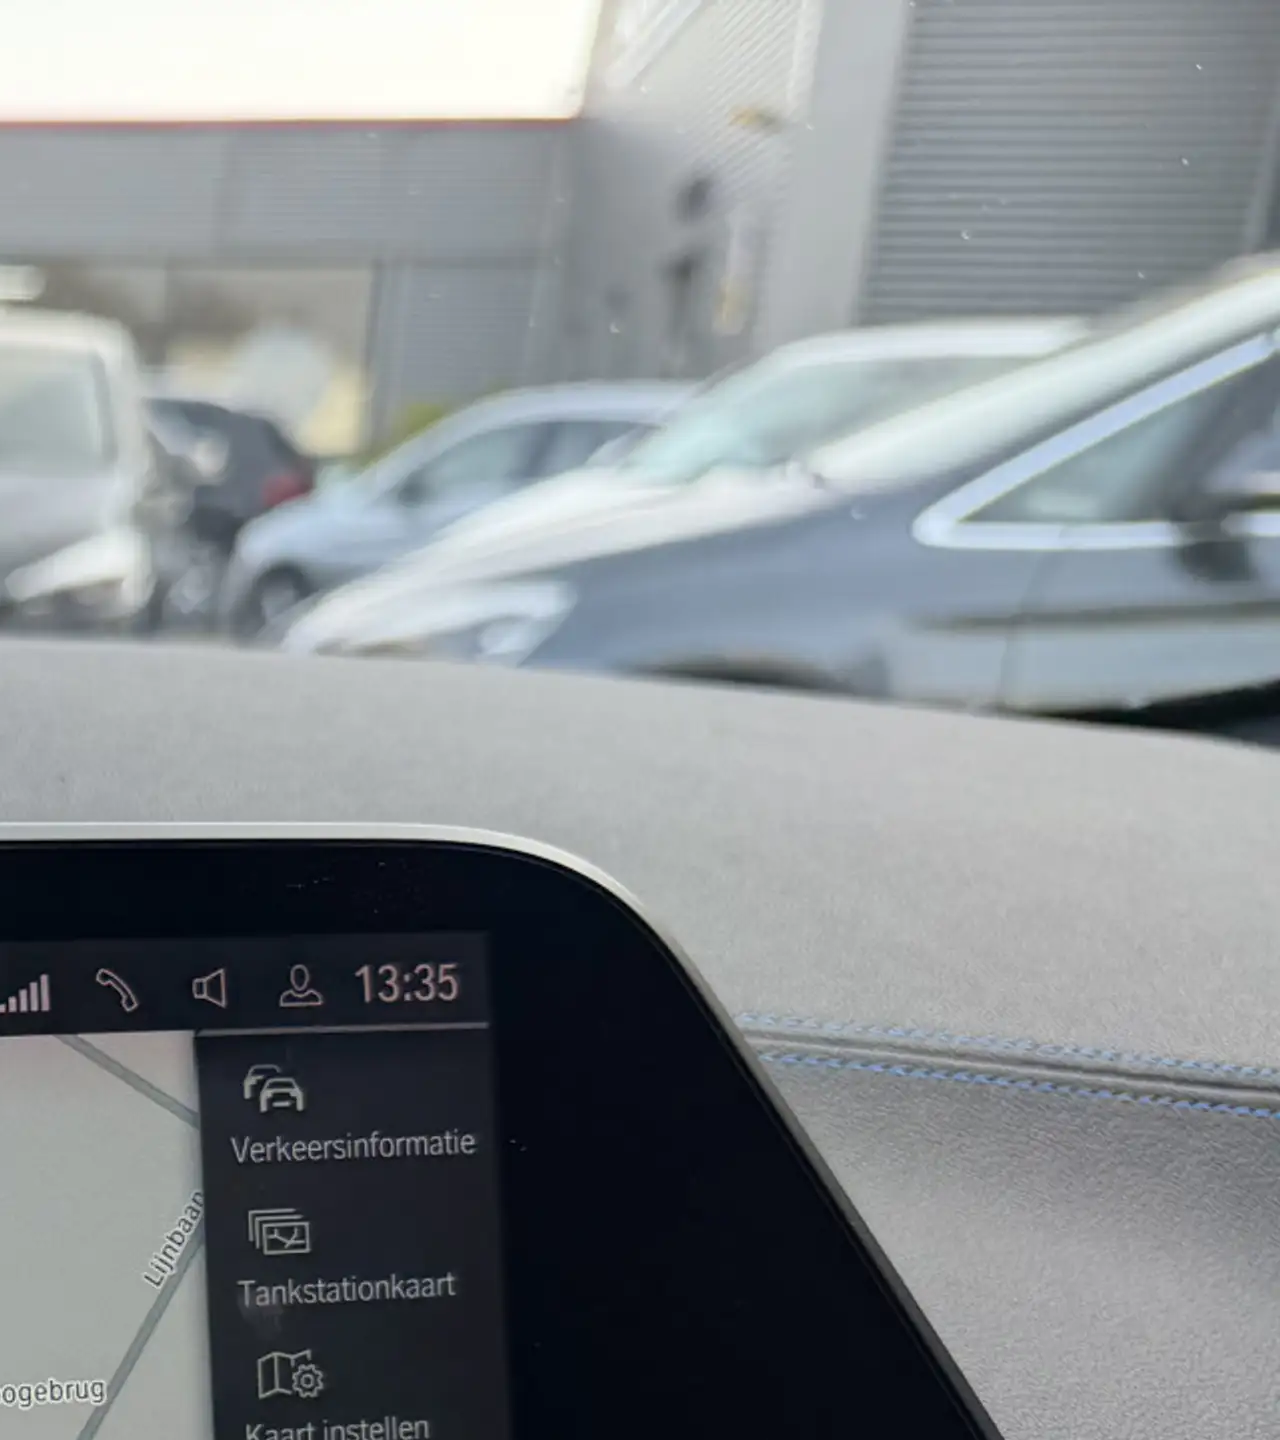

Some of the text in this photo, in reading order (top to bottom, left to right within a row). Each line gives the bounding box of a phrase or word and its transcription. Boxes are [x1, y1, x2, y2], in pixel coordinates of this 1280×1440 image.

[355, 963, 460, 1004] 13:35
[230, 1128, 477, 1165] Verkeersinformatie
[144, 1190, 204, 1288] Lijnbaan
[236, 1273, 457, 1309] Tankstationkaart
